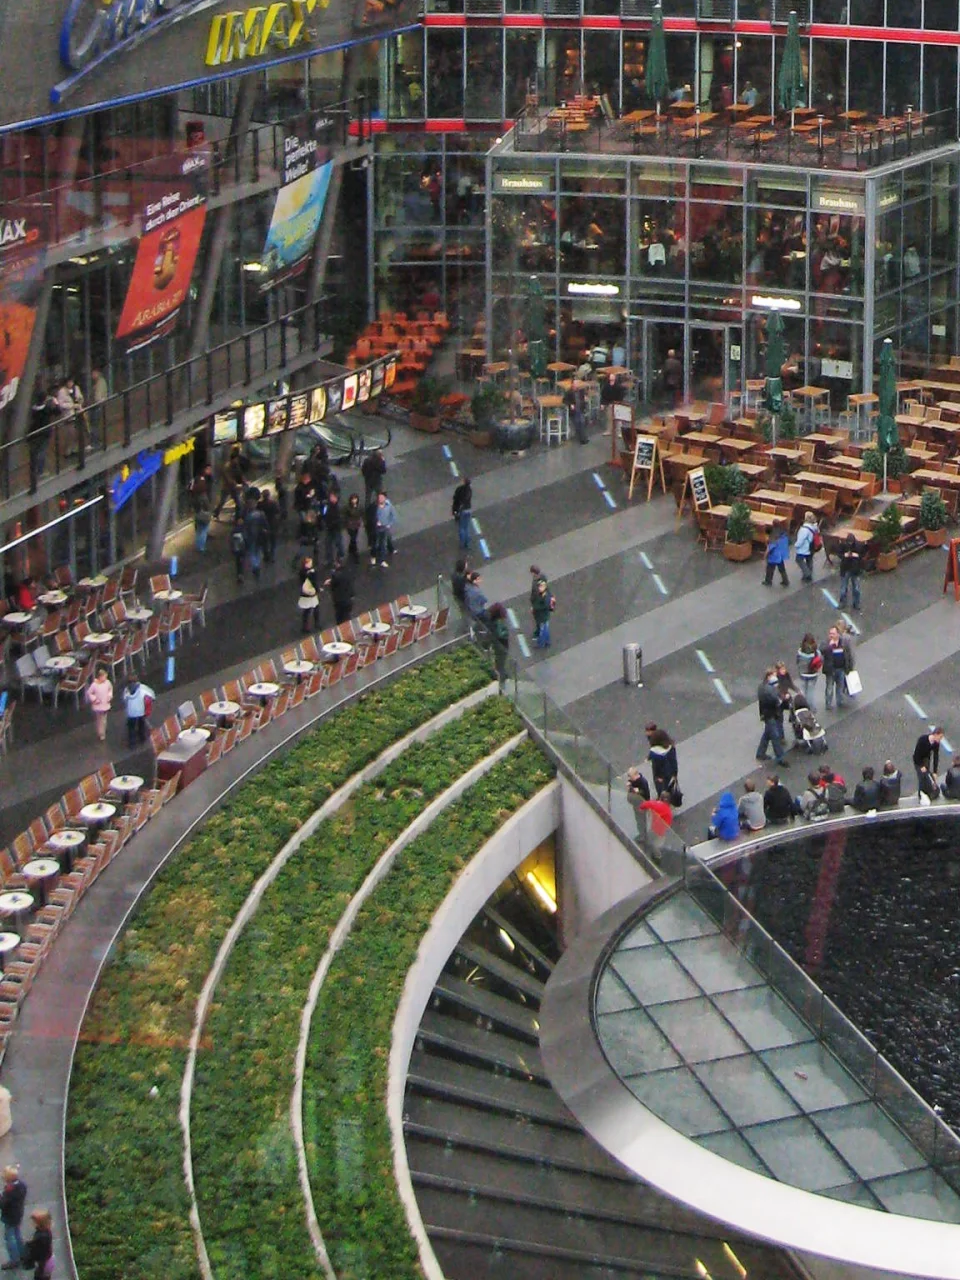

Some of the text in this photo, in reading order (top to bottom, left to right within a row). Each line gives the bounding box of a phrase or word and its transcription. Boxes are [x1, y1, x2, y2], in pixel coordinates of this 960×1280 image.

[285, 136, 299, 152] Die
[501, 177, 544, 189] Brauhaus
[819, 196, 858, 209] Brauhaus
